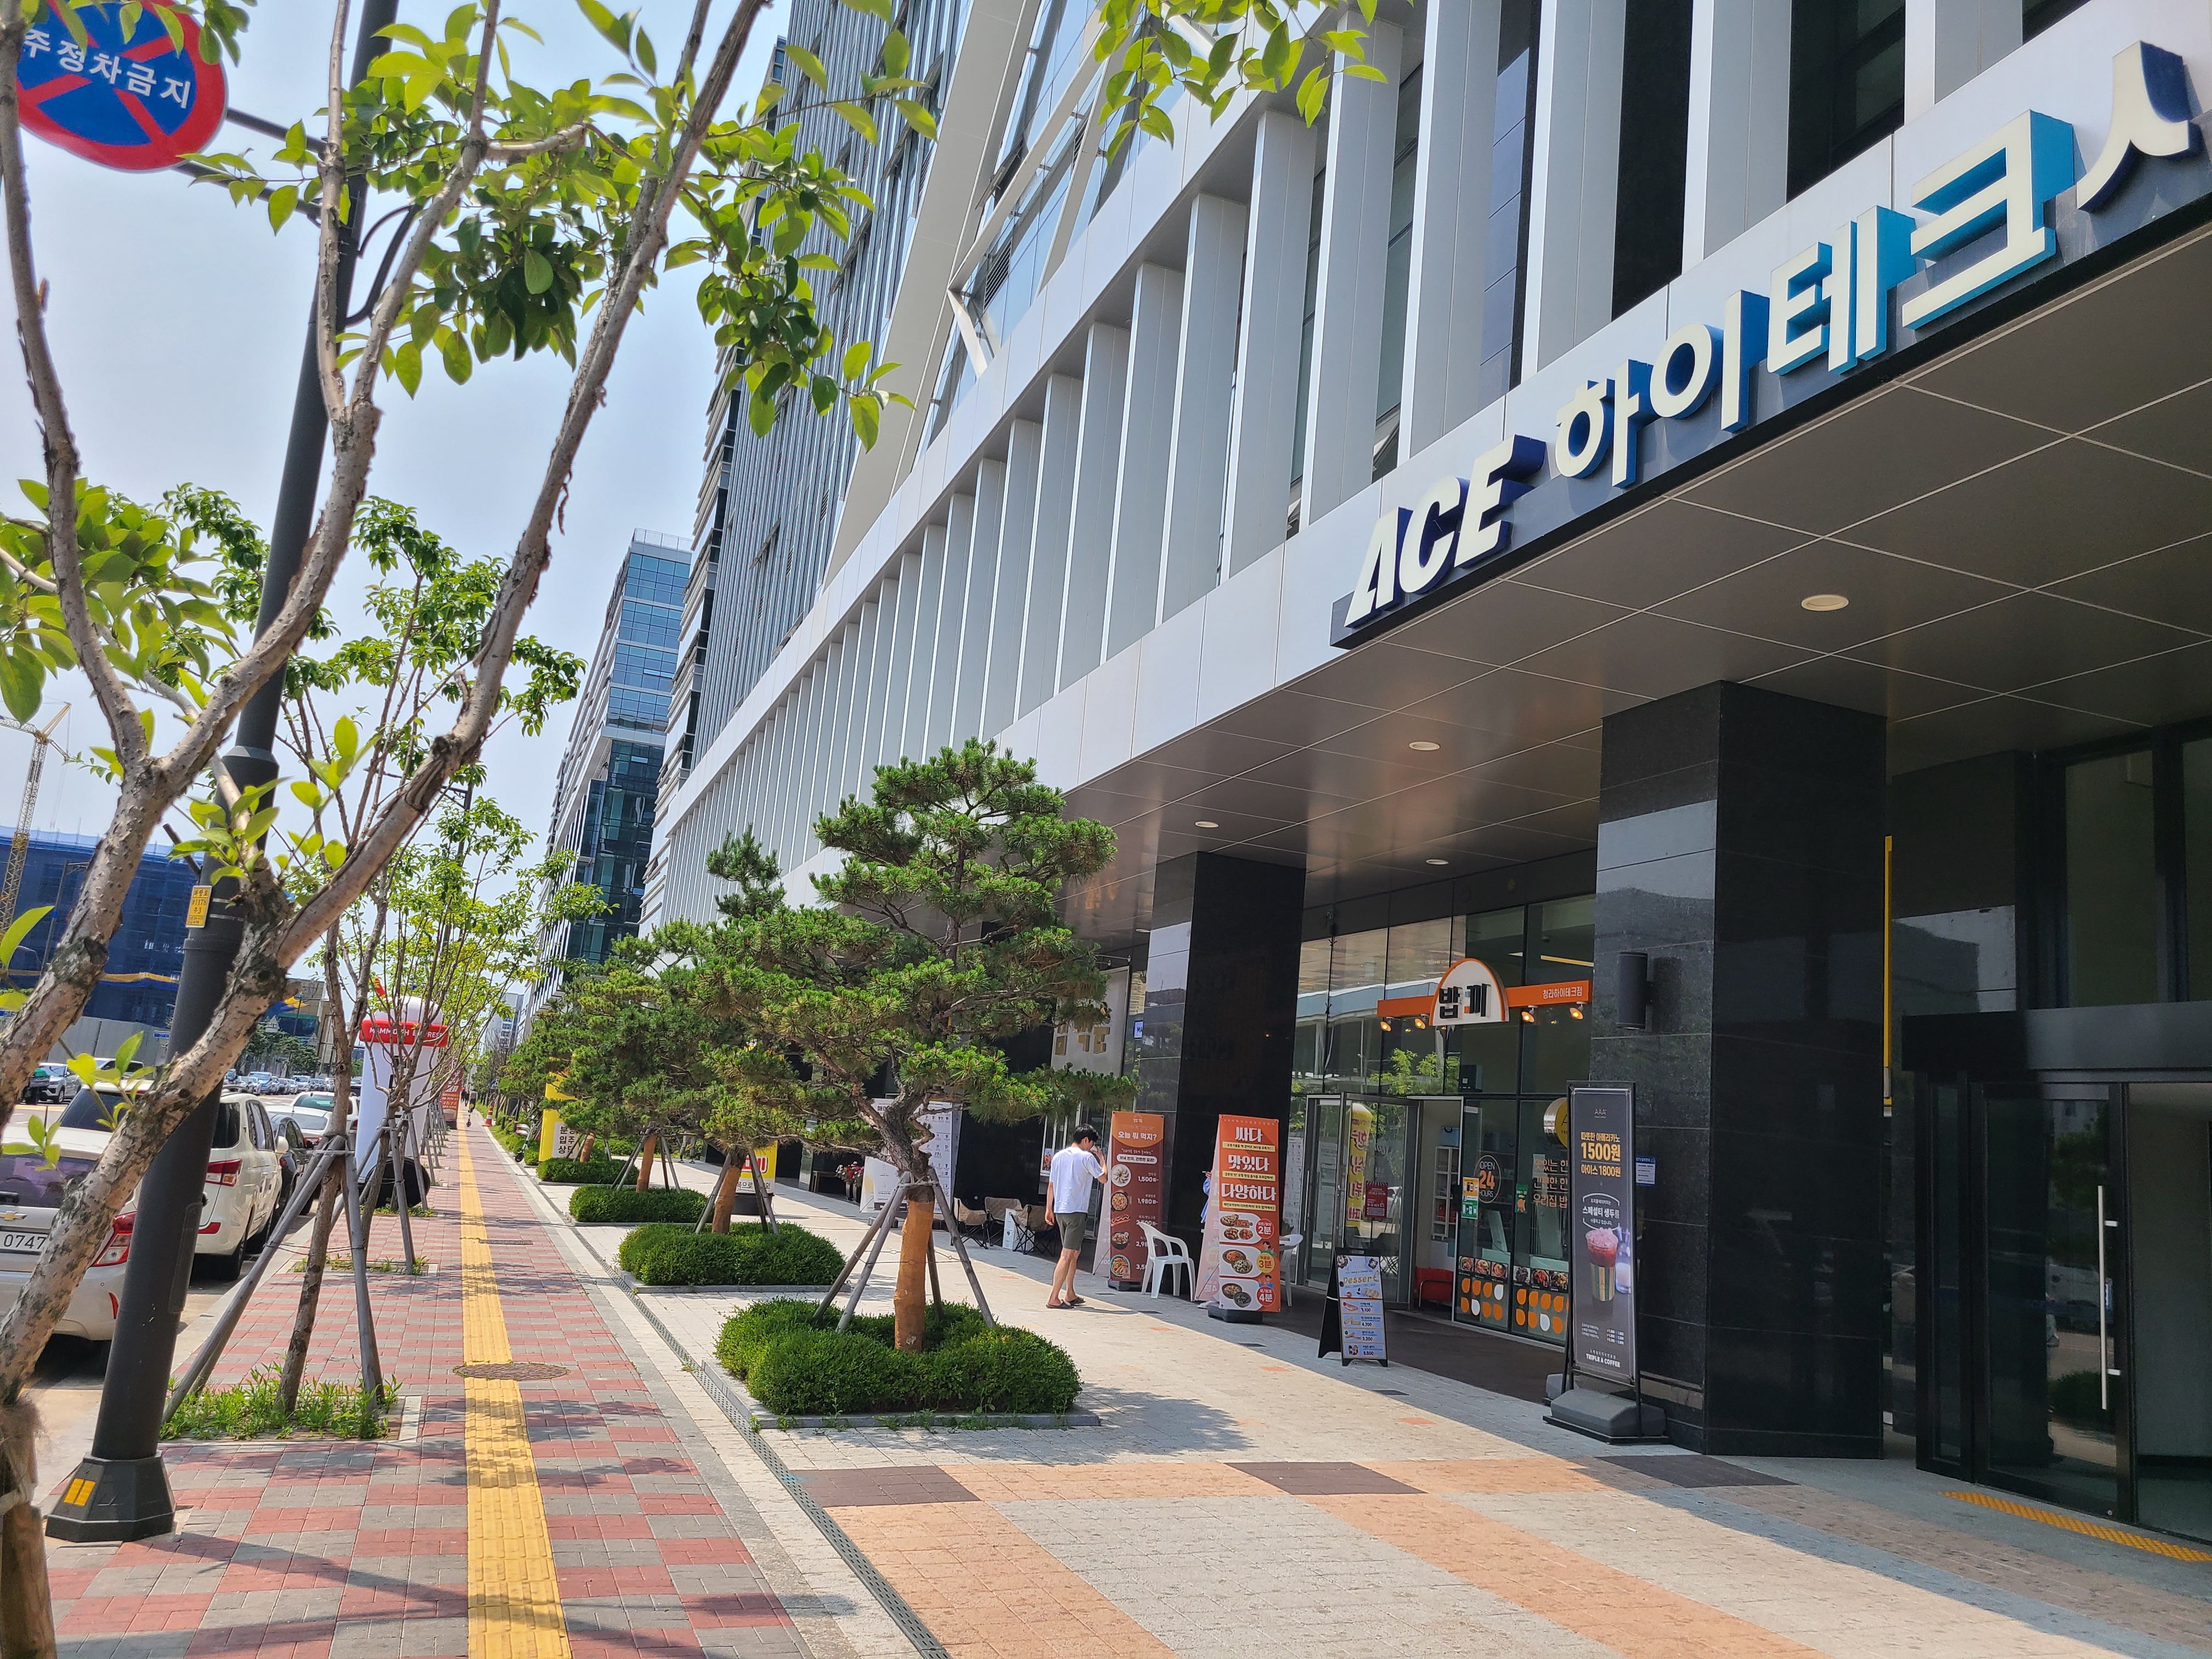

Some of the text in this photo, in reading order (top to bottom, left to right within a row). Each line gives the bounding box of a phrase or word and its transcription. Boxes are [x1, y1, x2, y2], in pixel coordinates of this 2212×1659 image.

[1343, 435, 1536, 628] ACE
[1543, 986, 1582, 999] 청라하이테크점
[369, 1027, 409, 1036] MMMOH
[1141, 1132, 1157, 1141] 먹지?
[1235, 1126, 1263, 1143] 싸다
[1581, 1132, 1621, 1142] 따뜻한 아메리카노
[1581, 1142, 1621, 1161] 1500원
[1228, 1154, 1270, 1171] 맛있다
[1480, 1161, 1495, 1170] OPEN
[1581, 1164, 1621, 1177] 아이스 1800원
[1479, 1170, 1495, 1189] 24
[1221, 1183, 1277, 1201] 다양하다
[1533, 1193, 1557, 1207] 우리집
[1582, 1206, 1603, 1217] 스페셜티
[1258, 1226, 1272, 1235] 2분
[4, 1234, 47, 1250] 0747
[1259, 1260, 1272, 1269] 3분
[1343, 1274, 1379, 1284] Dessert
[1259, 1293, 1273, 1302] 4분
[1585, 1353, 1600, 1362] TRIPLE
[1604, 1358, 1621, 1368] COFFEE
